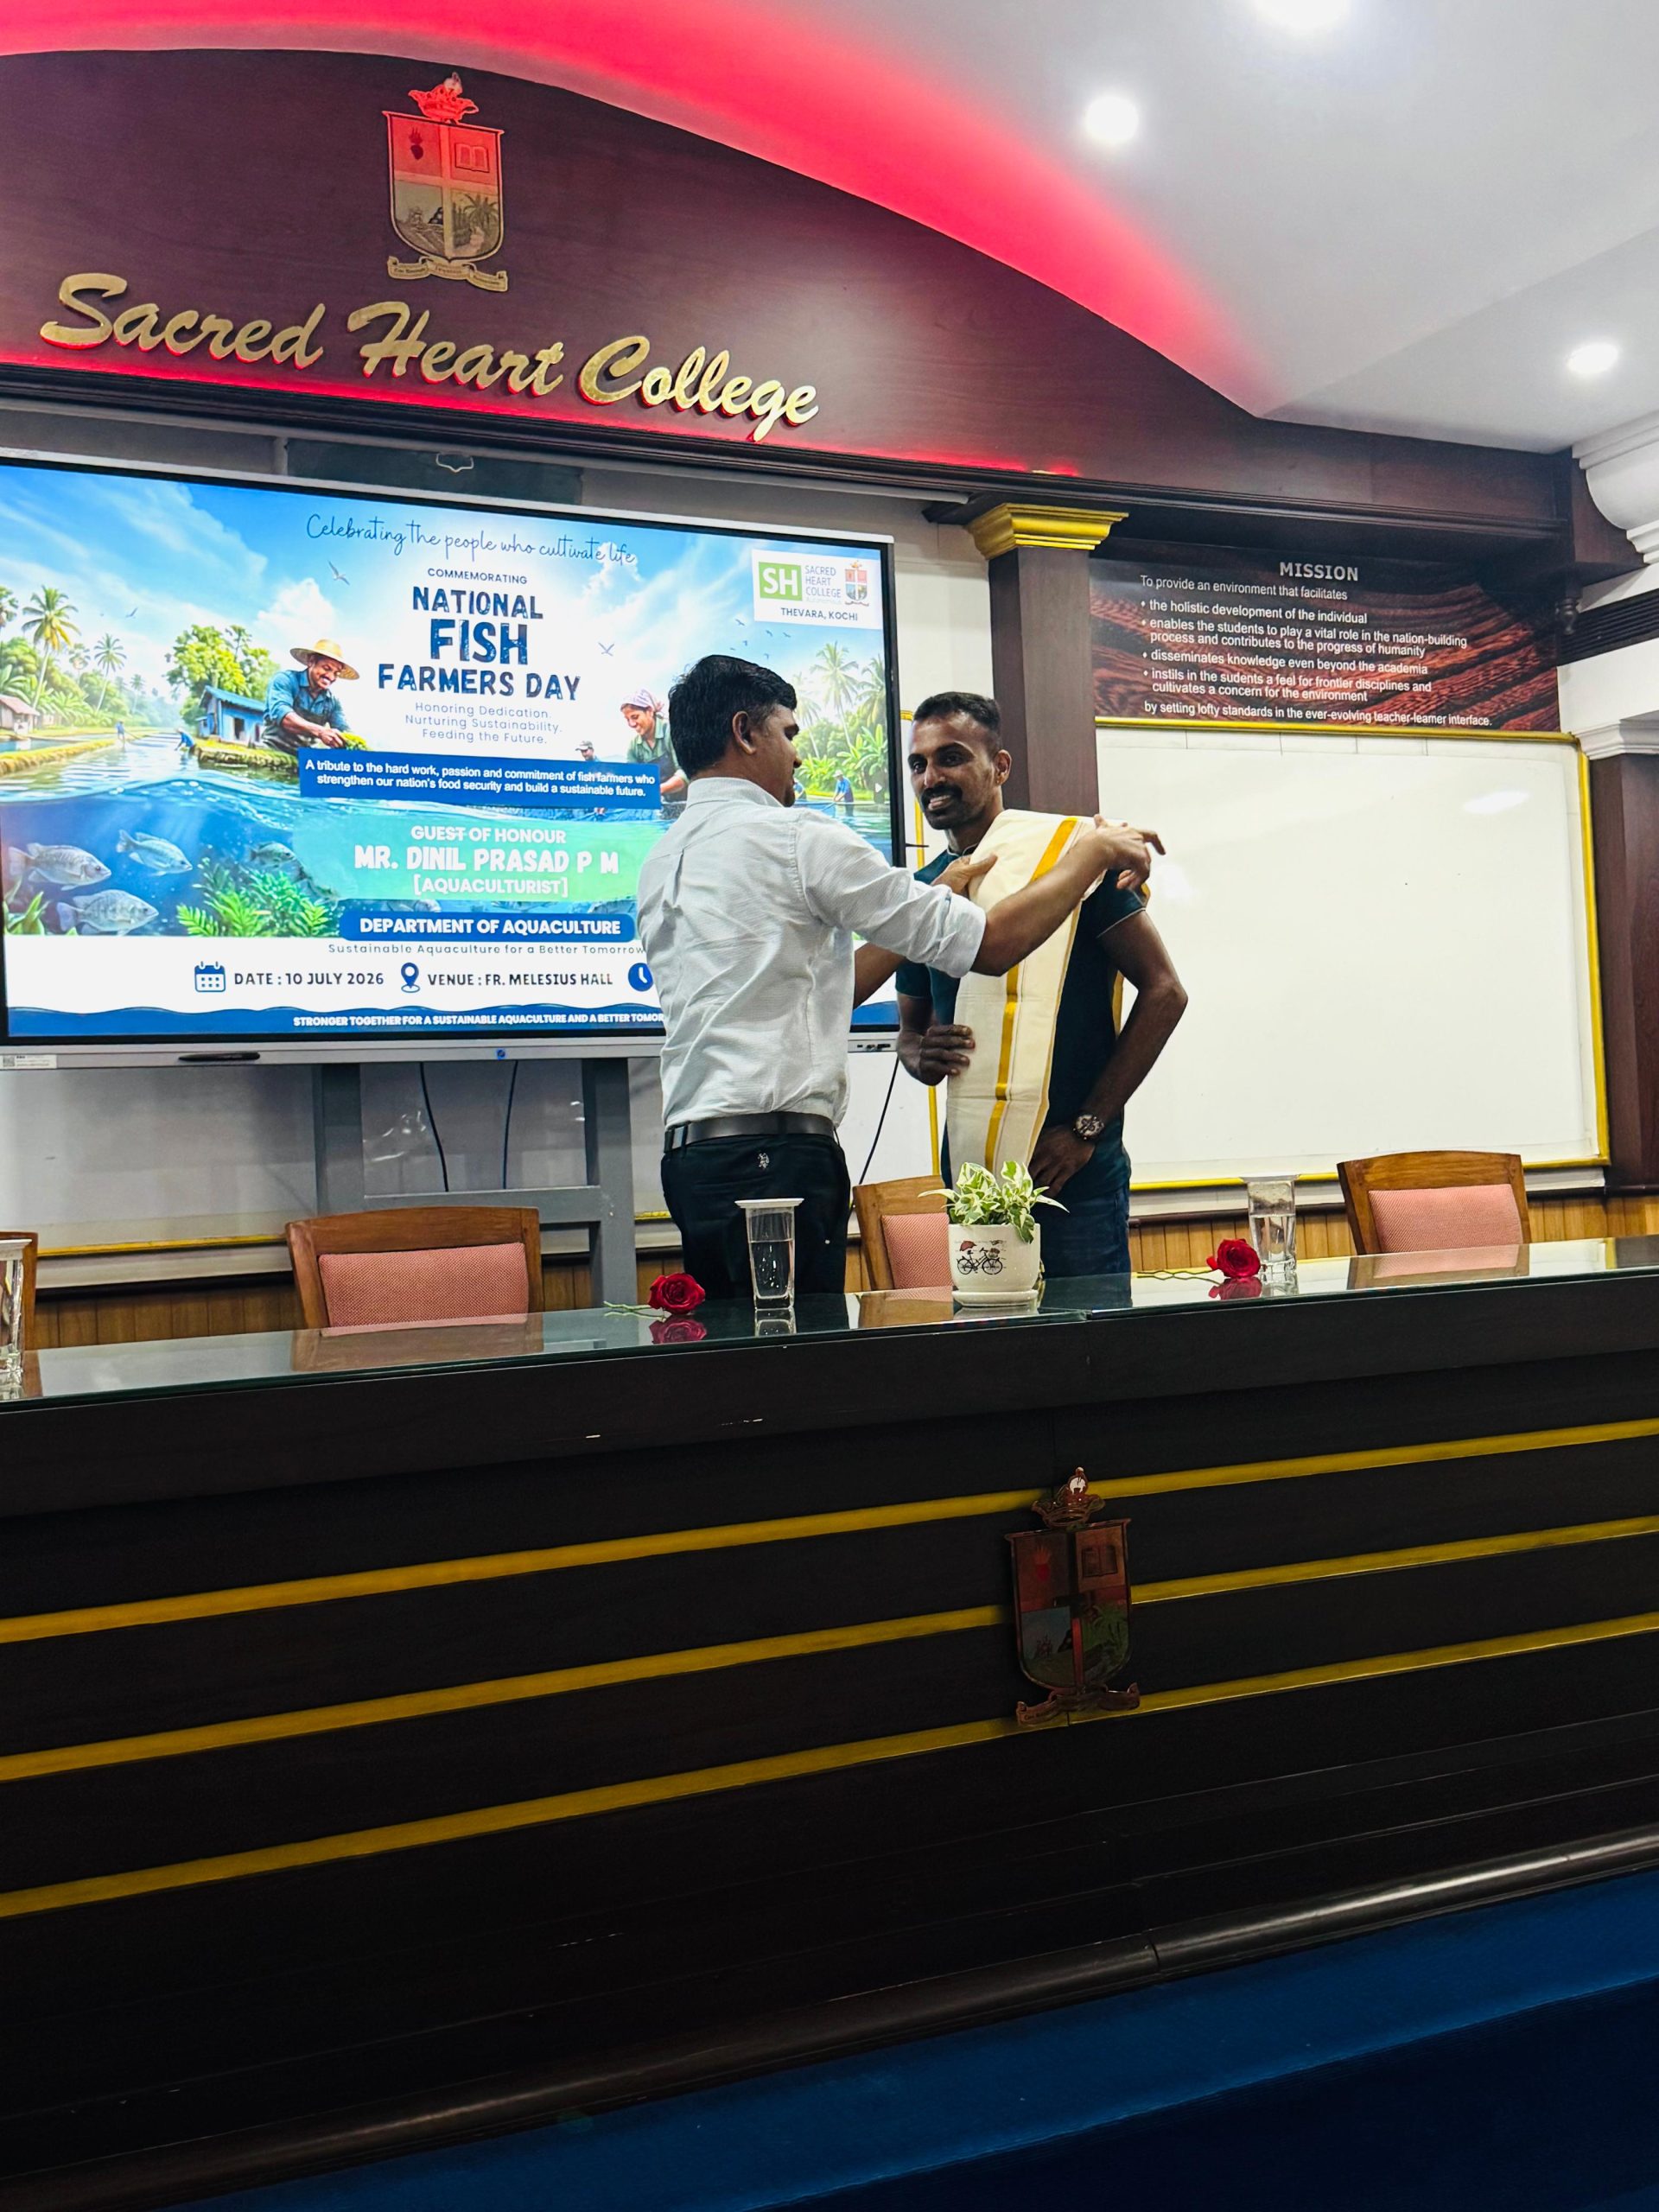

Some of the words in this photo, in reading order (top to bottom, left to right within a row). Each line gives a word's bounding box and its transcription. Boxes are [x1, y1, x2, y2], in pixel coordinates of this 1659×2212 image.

[41, 272, 327, 368] Sacred
[347, 300, 565, 397] Heart
[578, 334, 820, 442] College
[306, 513, 406, 556] Celebrating
[406, 519, 442, 546] the
[444, 529, 498, 563] people
[500, 532, 537, 555] who
[538, 534, 607, 561] cultivate
[608, 541, 638, 567] life
[427, 567, 529, 585] COMMEMORATING
[762, 566, 798, 596] SH
[804, 564, 836, 576] SACRED
[805, 576, 831, 587] HEART
[1279, 562, 1359, 582] MISSION
[805, 586, 842, 599] COLLEGE
[1140, 575, 1154, 588] To
[1155, 576, 1195, 590] provide
[1198, 581, 1211, 592] an
[1213, 581, 1277, 596] environment
[1279, 584, 1299, 598] that
[1300, 585, 1348, 601] facilitates
[412, 585, 543, 620] NATIONAL
[780, 607, 827, 620] THEVARA,
[829, 610, 859, 622] KOCHI
[1150, 599, 1167, 612] the
[1170, 601, 1210, 614] holistic
[1212, 602, 1283, 620] development
[1285, 606, 1297, 620] of
[1299, 608, 1316, 622] the
[1317, 610, 1368, 625] individual
[429, 618, 529, 666] FISH
[1150, 618, 1195, 631] enables
[1197, 619, 1215, 632] the
[1217, 620, 1264, 635] students
[1267, 623, 1278, 636] to
[1280, 623, 1302, 639] play
[1305, 629, 1313, 639] a
[1314, 626, 1337, 640] vital
[1338, 627, 1359, 641] role
[1362, 628, 1371, 641] in
[1374, 629, 1390, 643] the
[1392, 630, 1467, 648] nation-building
[1150, 632, 1195, 646] process
[1198, 633, 1218, 645] and
[1221, 634, 1281, 649] contributes
[1284, 638, 1295, 650] to
[1298, 639, 1314, 651] the
[1317, 641, 1363, 654] progress
[1365, 642, 1376, 653] of
[1378, 643, 1426, 658] humanity
[1151, 650, 1224, 664] disseminates
[1227, 653, 1286, 670] knowledge
[1288, 658, 1315, 669] even
[1317, 658, 1357, 673] beyond
[1359, 661, 1376, 672] the
[1377, 663, 1427, 675] academia
[378, 663, 515, 697] FARMERS
[525, 672, 582, 701] DAY
[1152, 668, 1185, 680] instils
[1186, 670, 1197, 681] in
[1199, 670, 1217, 683] the
[1220, 671, 1264, 685] sudents
[1267, 677, 1274, 685] a
[1275, 675, 1296, 686] feel
[1298, 676, 1313, 688] for
[1315, 677, 1354, 689] frontier
[1356, 677, 1410, 692] disciplines
[1412, 681, 1432, 692] and
[1152, 681, 1205, 695] cultivates
[1208, 685, 1216, 695] a
[1218, 686, 1262, 698] concern
[1265, 685, 1279, 698] for
[1282, 687, 1300, 699] the
[1301, 690, 1368, 702] environment
[415, 702, 474, 716] Honoring
[479, 706, 552, 720] Dedication.
[1145, 701, 1158, 713] by
[1160, 702, 1195, 716] setting
[1198, 704, 1219, 717] lofty
[1222, 706, 1273, 718] standards
[1275, 707, 1285, 718] in
[1287, 708, 1303, 719] the
[1305, 709, 1372, 723] ever-evolving
[1374, 711, 1446, 725] teacher-learner
[1448, 715, 1493, 727] interface.
[405, 715, 467, 729] Nurturing
[472, 719, 563, 734] Sustainability.
[423, 728, 474, 743] Feeding
[479, 731, 499, 741] the
[504, 733, 547, 744] Future.
[305, 759, 315, 771] A
[317, 760, 351, 772] tribute
[353, 762, 364, 772] to
[366, 762, 383, 773] the
[385, 763, 410, 774] hard
[411, 766, 439, 777] work,
[442, 767, 481, 779] passion
[483, 768, 502, 779] and
[505, 769, 564, 781] commitment
[566, 771, 576, 781] of
[577, 771, 595, 782] fish
[597, 772, 633, 785] farmers
[635, 774, 656, 785] who
[317, 773, 374, 787] strengthen
[376, 778, 393, 787] our
[396, 777, 435, 790] nation's
[438, 778, 461, 790] food
[463, 779, 502, 793] security
[504, 781, 524, 793] and
[525, 782, 550, 793] build
[550, 785, 558, 794] a
[561, 784, 614, 796] sustainable
[615, 785, 646, 798] future.
[410, 824, 467, 842] GUEST
[468, 827, 493, 842] OF
[494, 828, 567, 844] HONOUR
[354, 844, 398, 870] MR.
[406, 845, 467, 872] DINIL
[474, 848, 569, 873] PRASAD
[576, 850, 593, 874] P
[600, 851, 620, 874] M
[413, 874, 569, 898] [AQUACULTURIST]
[359, 918, 474, 934] DEPARTMENT
[476, 918, 499, 934] OF
[502, 919, 621, 936] AQUACULTURE
[328, 944, 412, 954] Sustainable
[416, 944, 500, 957] Aquaculture
[505, 944, 519, 954] for
[539, 945, 577, 955] Better
[582, 945, 645, 955] Tomorrow
[234, 972, 273, 986] DATE
[285, 972, 302, 986] 10
[307, 972, 343, 986] JULY
[347, 972, 385, 986] 2026
[428, 974, 475, 987] VENUE
[485, 974, 505, 987] FR.
[509, 973, 577, 987] MELESIUS
[580, 973, 613, 986] HALL
[293, 1015, 348, 1027] STRONGER
[349, 1015, 402, 1027] TOGETHER
[403, 1015, 423, 1027] FOR
[423, 1015, 432, 1026] A
[432, 1014, 497, 1026] SUSTAINABLE
[498, 1014, 567, 1026] AQUACULTURE
[567, 1014, 588, 1025] AND
[589, 1014, 598, 1024] A
[598, 1013, 632, 1023] BETTER
[631, 1013, 664, 1023] TOMOR
